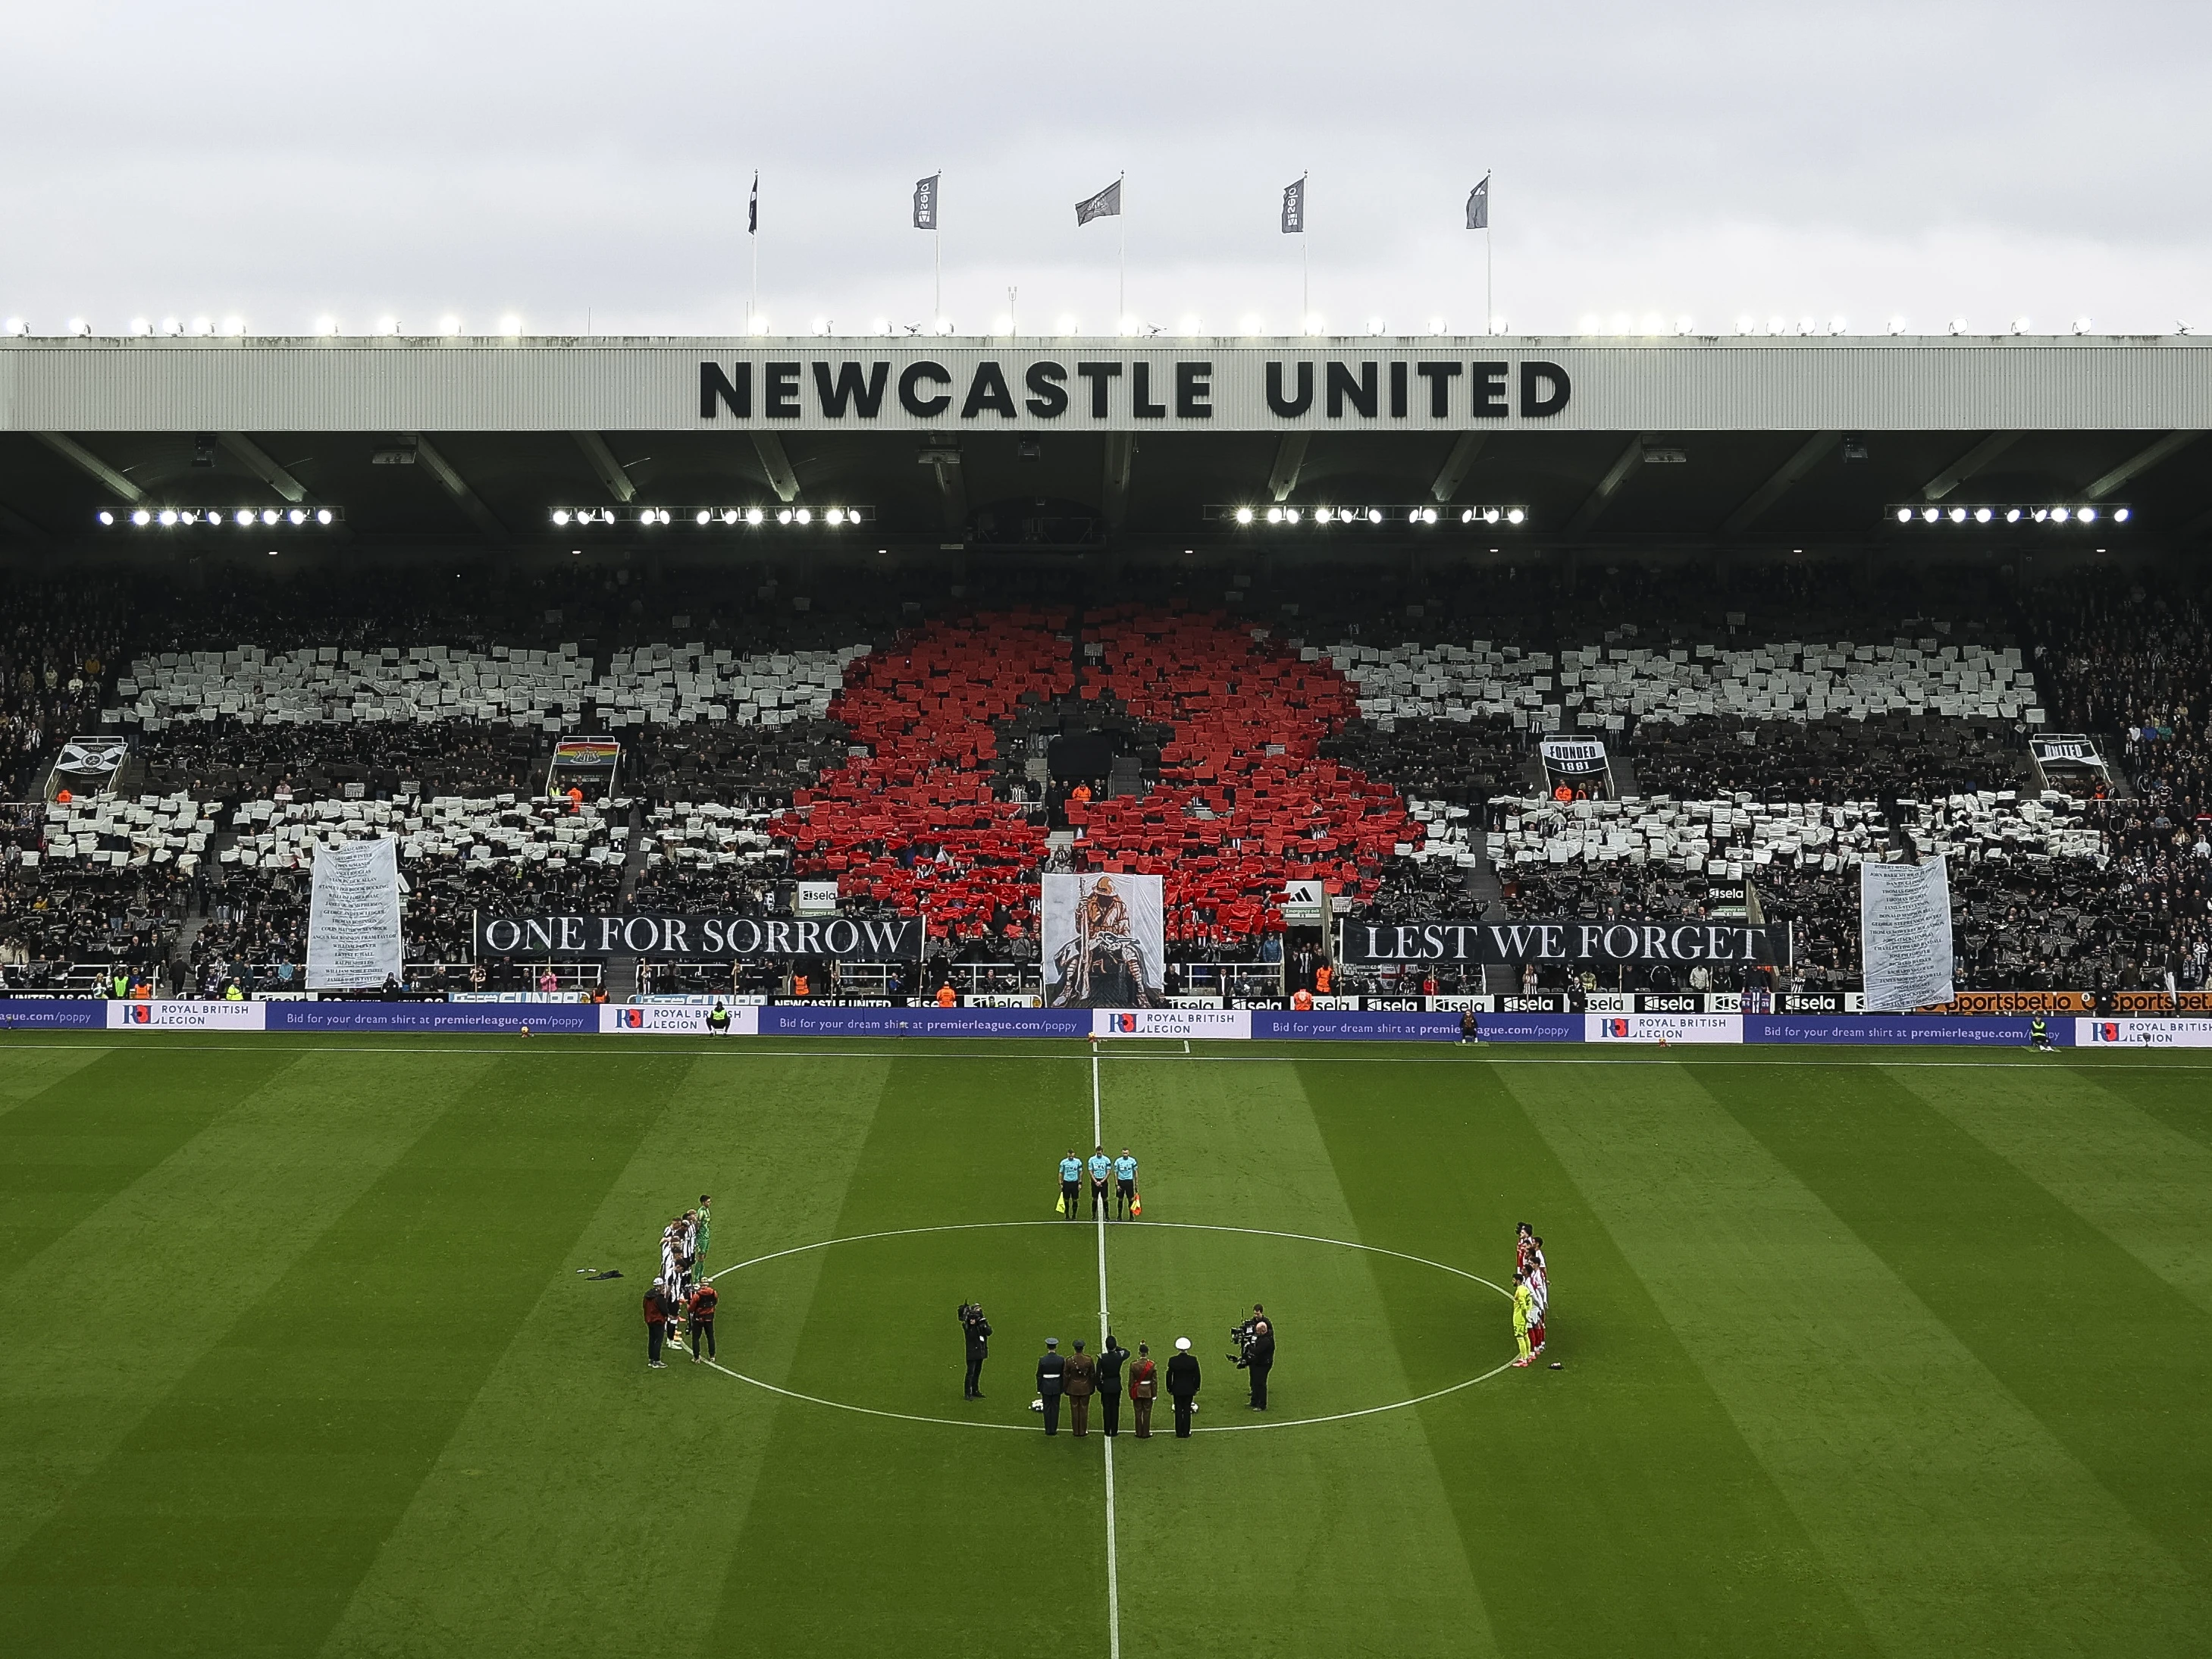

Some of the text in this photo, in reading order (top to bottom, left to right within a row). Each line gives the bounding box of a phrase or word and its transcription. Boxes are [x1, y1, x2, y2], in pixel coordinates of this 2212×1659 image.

[700, 361, 1571, 420] NEWCASTLE UNITED
[1549, 745, 1596, 759] FOUNDED
[2044, 745, 2083, 757] UNITED
[1560, 761, 1589, 770] 1881
[813, 890, 836, 900] sela
[1719, 888, 1744, 898] sela
[486, 917, 910, 954] ONE FOR SORROW
[1364, 924, 1766, 960] LEST WE FORGET
[1248, 1000, 1282, 1010] sela
[1316, 999, 1350, 1011] sela
[1383, 999, 1418, 1011] sela
[1451, 999, 1485, 1012] sela
[1519, 996, 1554, 1011] sela
[1590, 996, 1624, 1011] sela
[1660, 996, 1694, 1011] sela
[1800, 995, 1835, 1010] sela
[161, 1005, 249, 1015] ROYAL BRITISH
[653, 1009, 741, 1019] ROYAL BRSH
[161, 1017, 205, 1025] LEGION
[287, 1013, 304, 1023] Bid
[307, 1013, 324, 1023] for
[327, 1017, 351, 1026] your
[354, 1014, 387, 1024] dream
[391, 1015, 416, 1024] shirt
[434, 1015, 584, 1028] premierleague.com/poppy
[1147, 1014, 1234, 1023] ROYAL BRITISH
[1639, 1018, 1726, 1027] ROYAL BRITISH
[653, 1021, 697, 1030] LEGION
[780, 1018, 797, 1027] Bid
[800, 1018, 816, 1027] for
[819, 1021, 844, 1031] your
[848, 1019, 880, 1029] dream
[927, 1019, 1077, 1033] premierleague.com/poppy
[1147, 1025, 1190, 1033] LEGION
[1273, 1022, 1289, 1032] Bid
[1292, 1022, 1309, 1032] for
[1312, 1025, 1336, 1035] your
[1340, 1023, 1373, 1033] dream
[1377, 1024, 1402, 1033] shirt
[1420, 1024, 1569, 1037] premieague.com/poppy
[2129, 1023, 2166, 1031] ROYAL
[1639, 1030, 1683, 1038] LEGION
[1765, 1026, 1781, 1036] Bid
[1784, 1027, 1801, 1036] for
[1804, 1030, 1828, 1039] your
[1831, 1027, 1865, 1036] dream
[1869, 1027, 1893, 1037] shirt
[1911, 1027, 2060, 1041] premierleague.com/py
[2129, 1034, 2173, 1043] LEION
